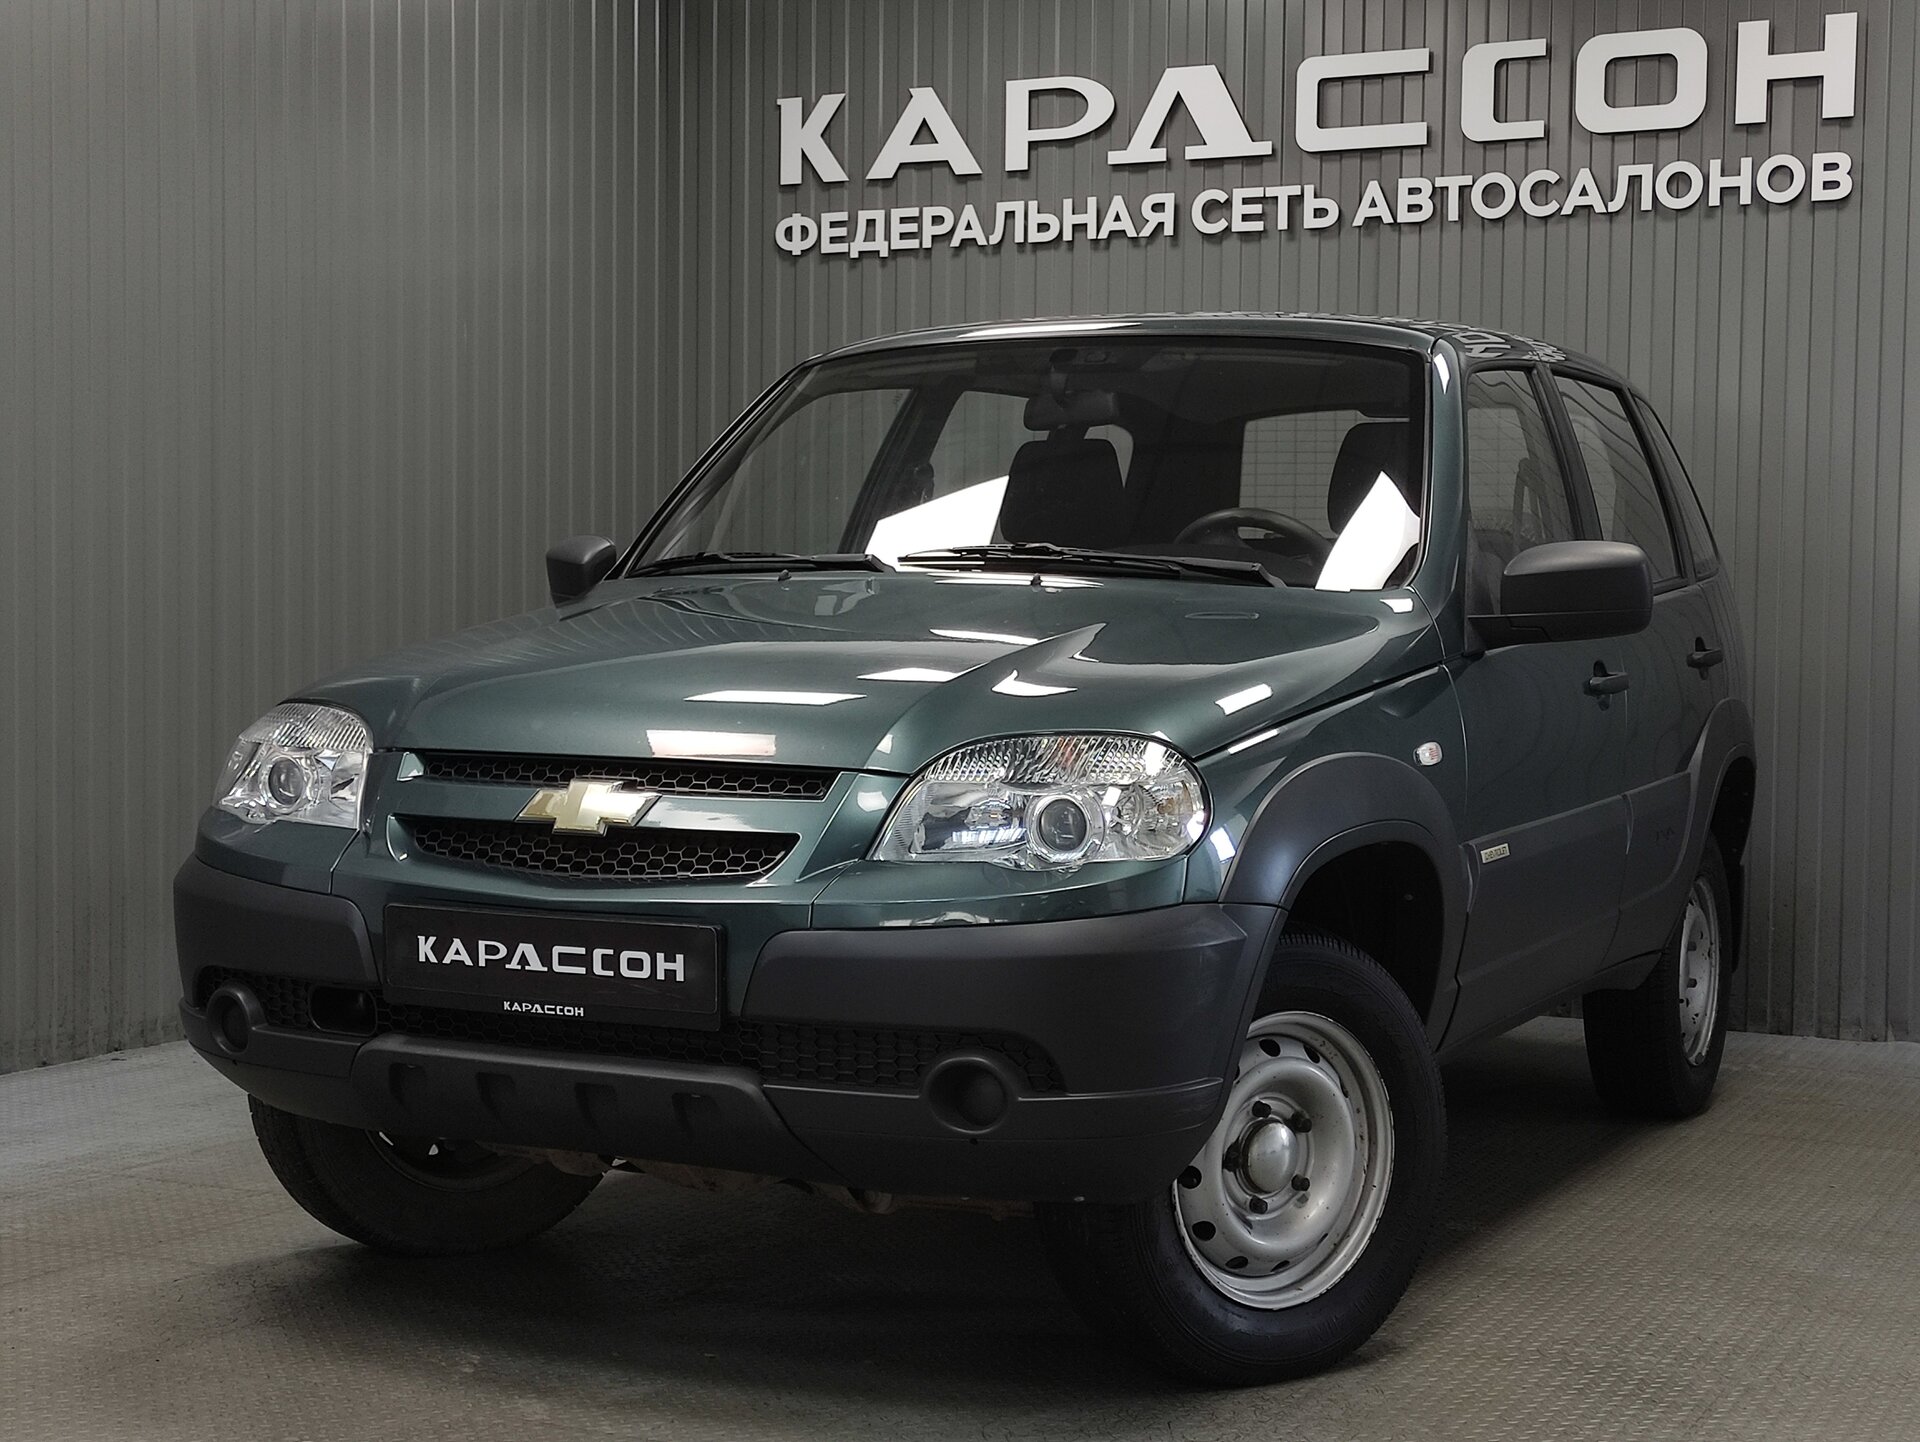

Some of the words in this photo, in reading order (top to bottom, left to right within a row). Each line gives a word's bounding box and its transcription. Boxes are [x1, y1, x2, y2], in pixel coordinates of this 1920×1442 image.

[775, 193, 1176, 258] ФЕДЕРАЛЬНАЯ
[1190, 184, 1340, 235] СЕТЬ
[1352, 152, 1854, 227] АВТОСАЛОНОВ
